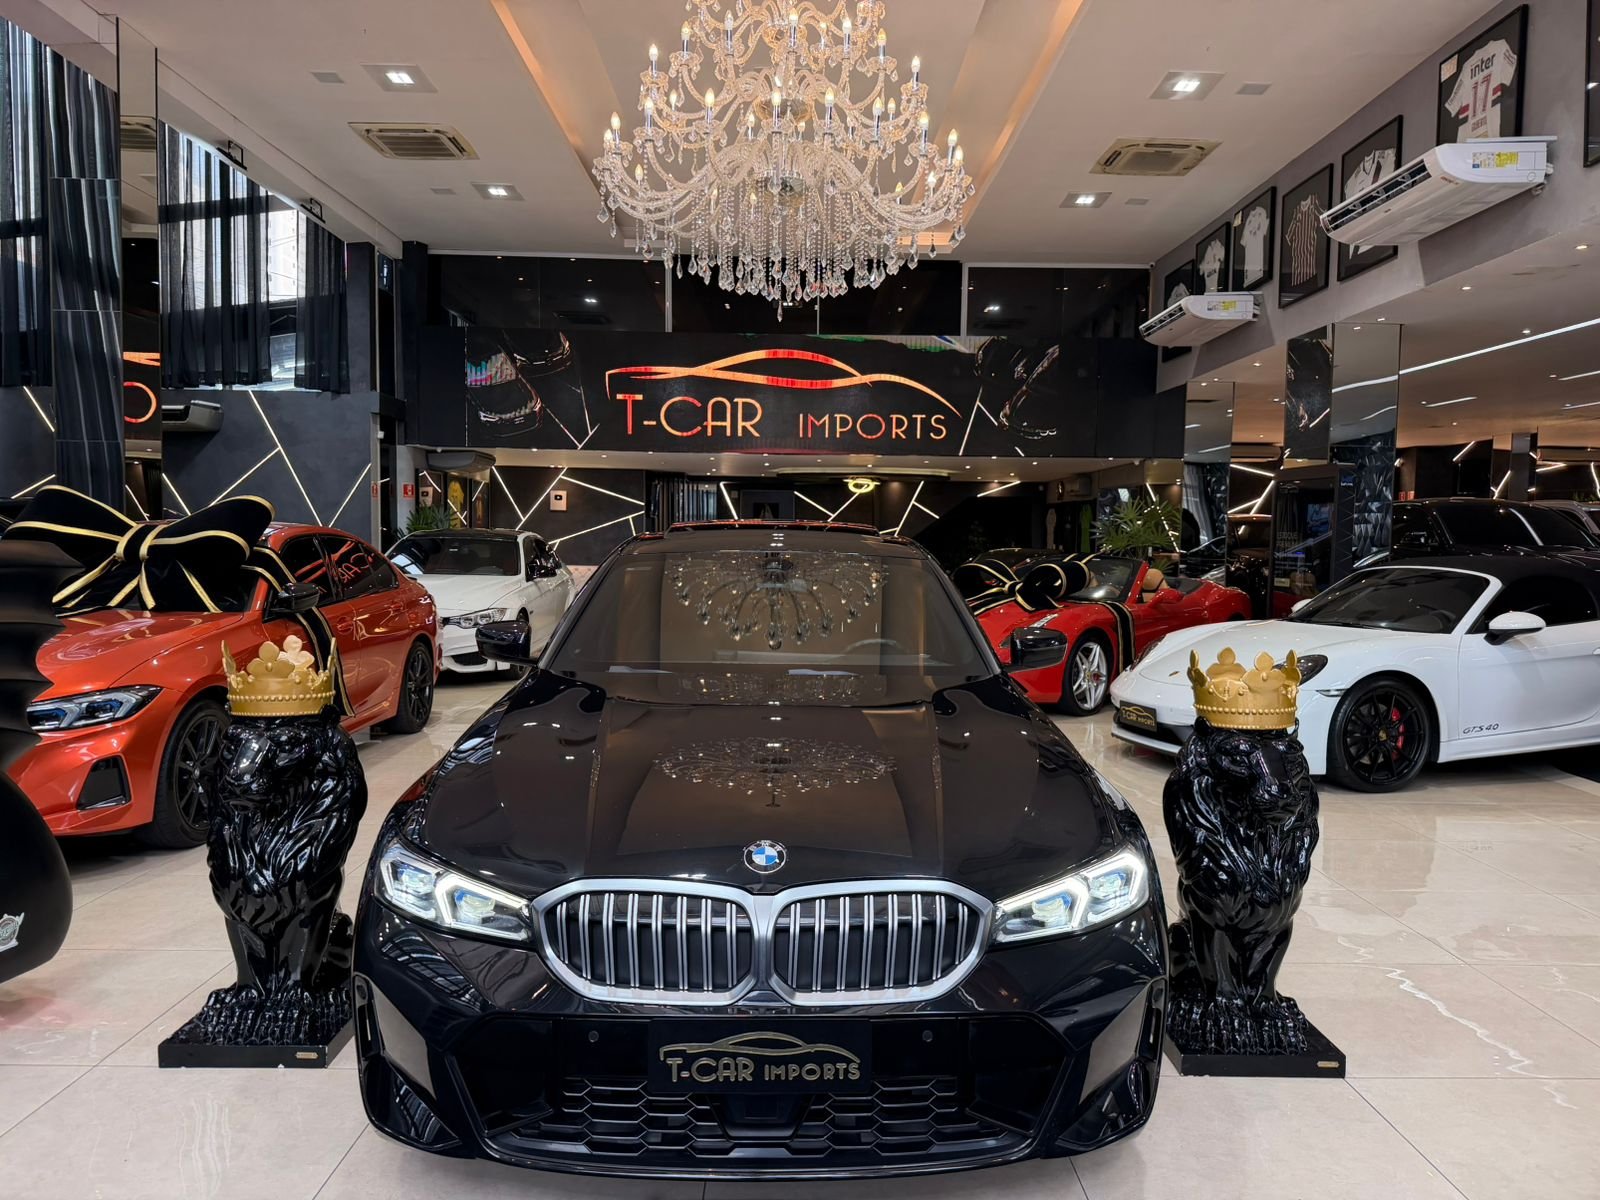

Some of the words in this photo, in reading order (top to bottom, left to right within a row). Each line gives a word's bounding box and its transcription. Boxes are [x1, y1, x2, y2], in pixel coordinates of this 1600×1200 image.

[1470, 53, 1496, 80] inter
[616, 393, 762, 438] T-CAR
[799, 412, 947, 440] IMPORTS
[666, 1057, 755, 1083] T-CAR
[764, 1062, 861, 1082] IMPORTS
